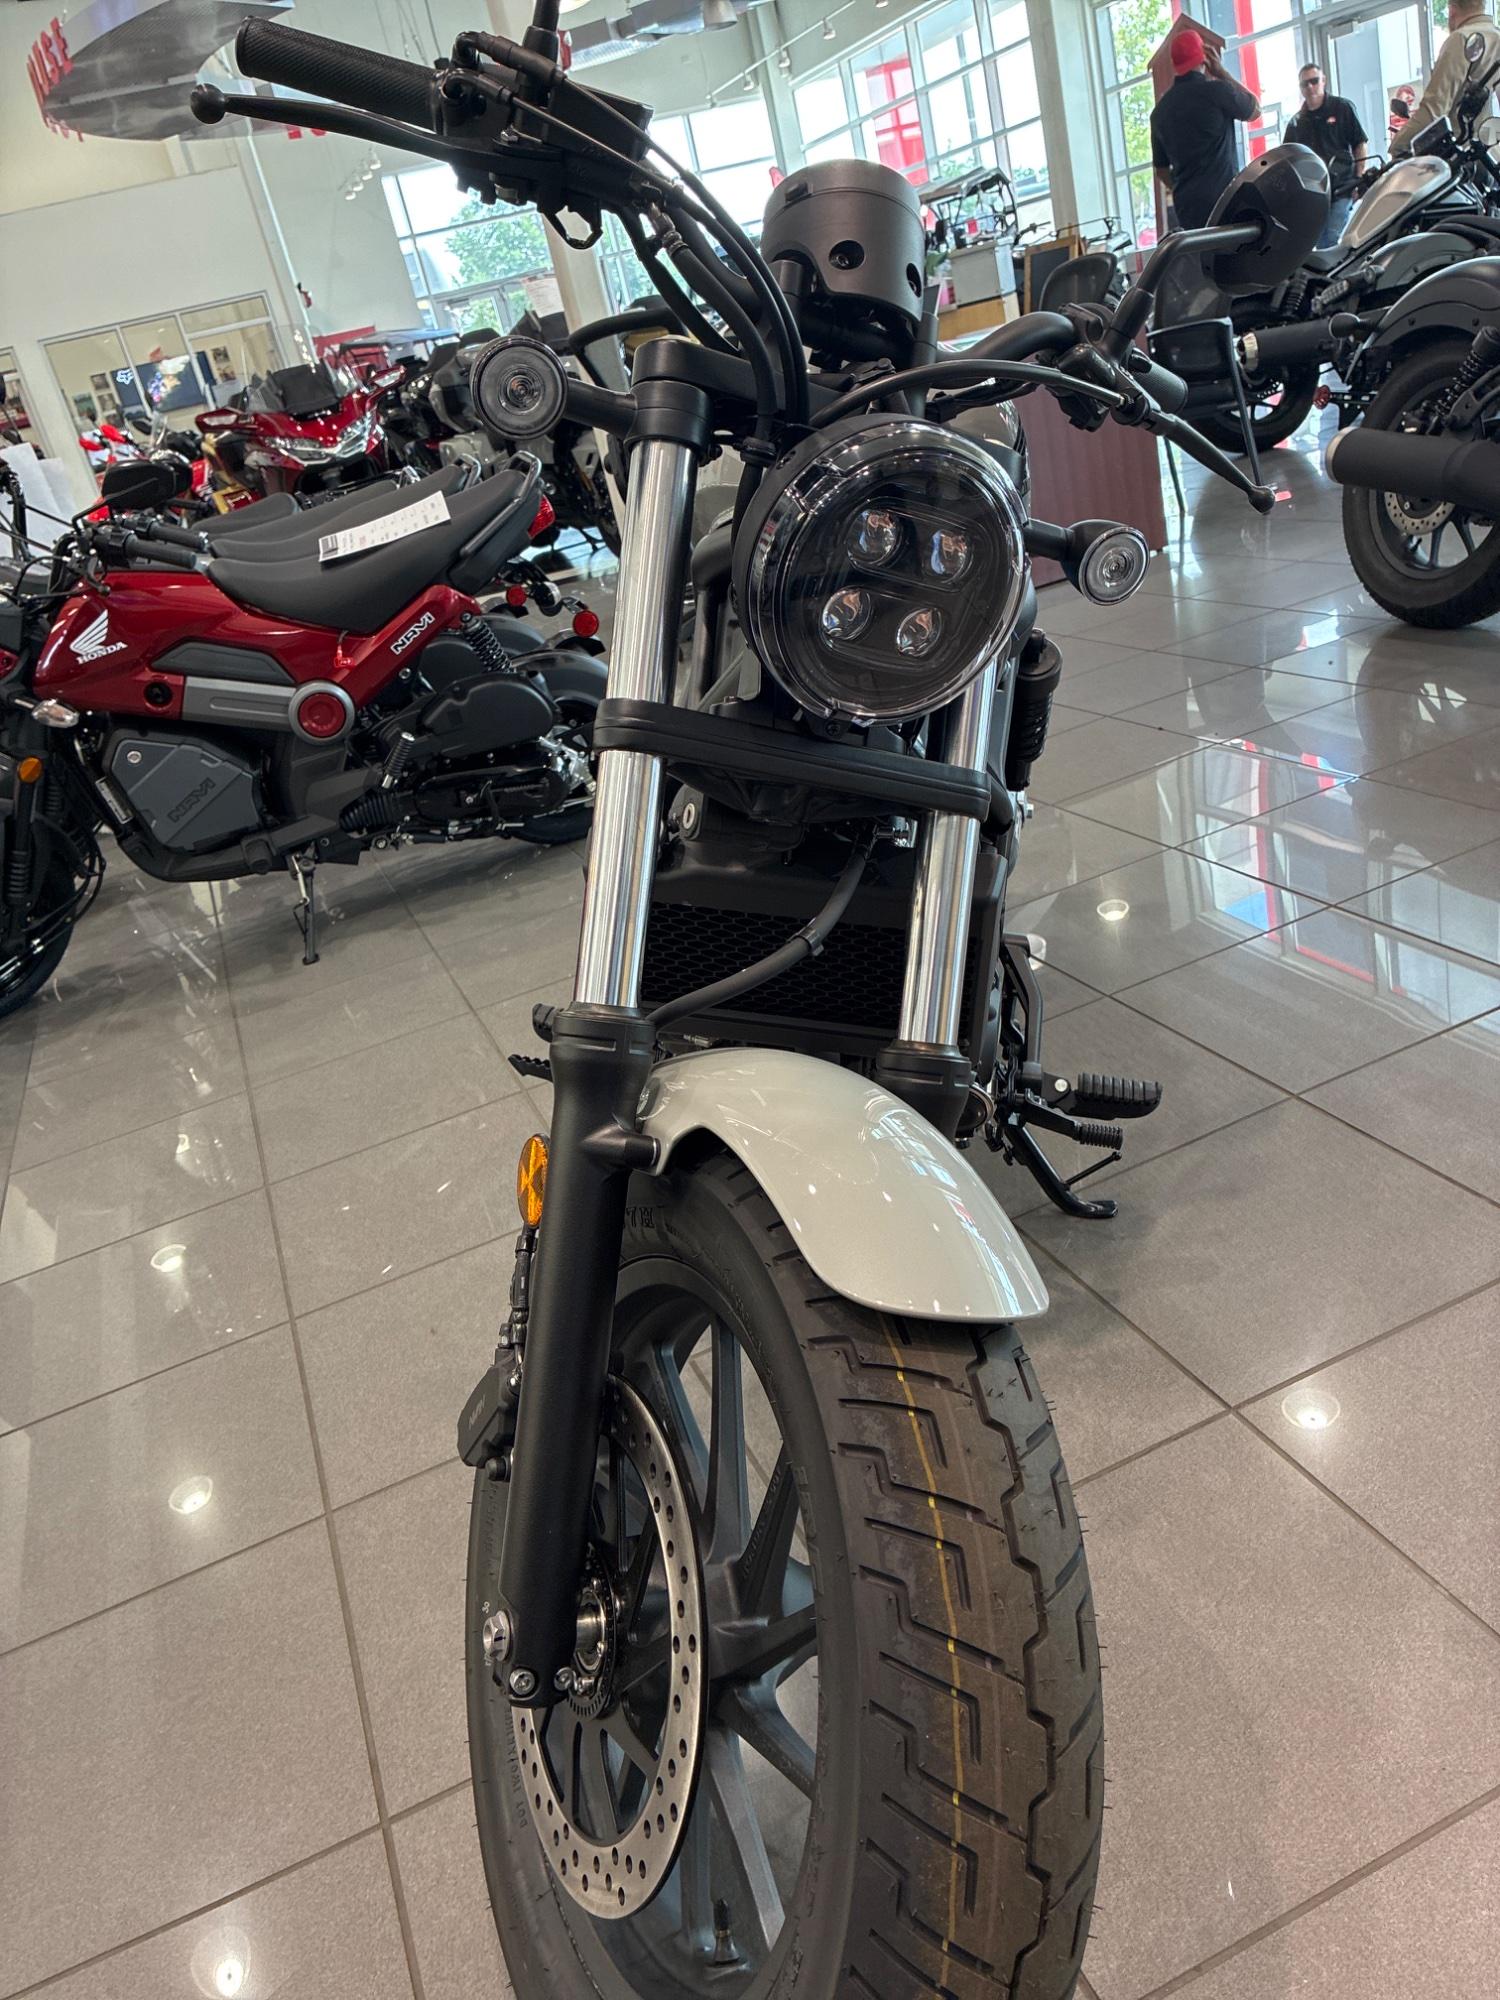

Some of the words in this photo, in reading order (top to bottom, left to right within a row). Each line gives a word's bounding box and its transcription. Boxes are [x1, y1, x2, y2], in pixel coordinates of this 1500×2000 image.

[76, 641, 128, 664] HONDA
[390, 611, 436, 656] NAVI
[167, 777, 216, 823] NAVI
